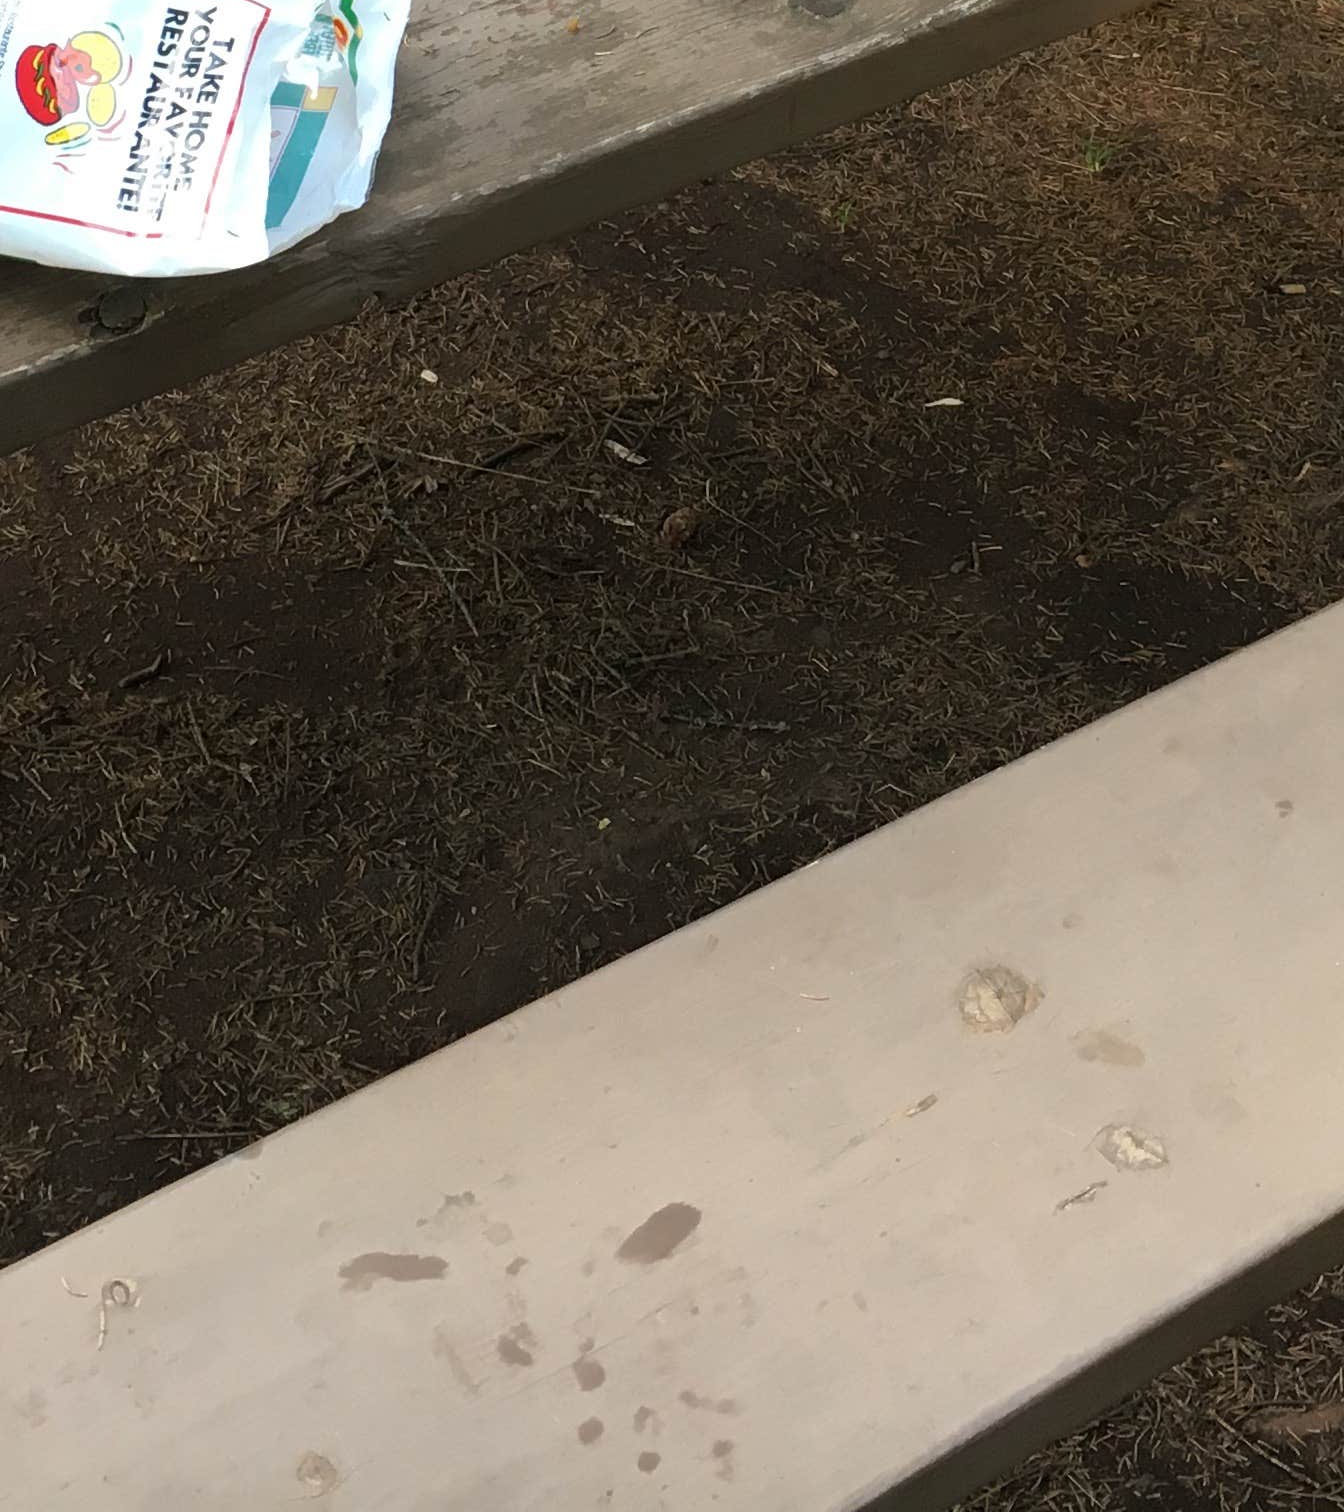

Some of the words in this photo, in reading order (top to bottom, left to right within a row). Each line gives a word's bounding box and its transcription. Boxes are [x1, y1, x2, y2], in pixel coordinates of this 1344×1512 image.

[179, 6, 217, 78] YOUR
[197, 38, 235, 104] TAKE
[117, 8, 189, 212] RESTAURANTE!
[174, 111, 212, 191] HOME
